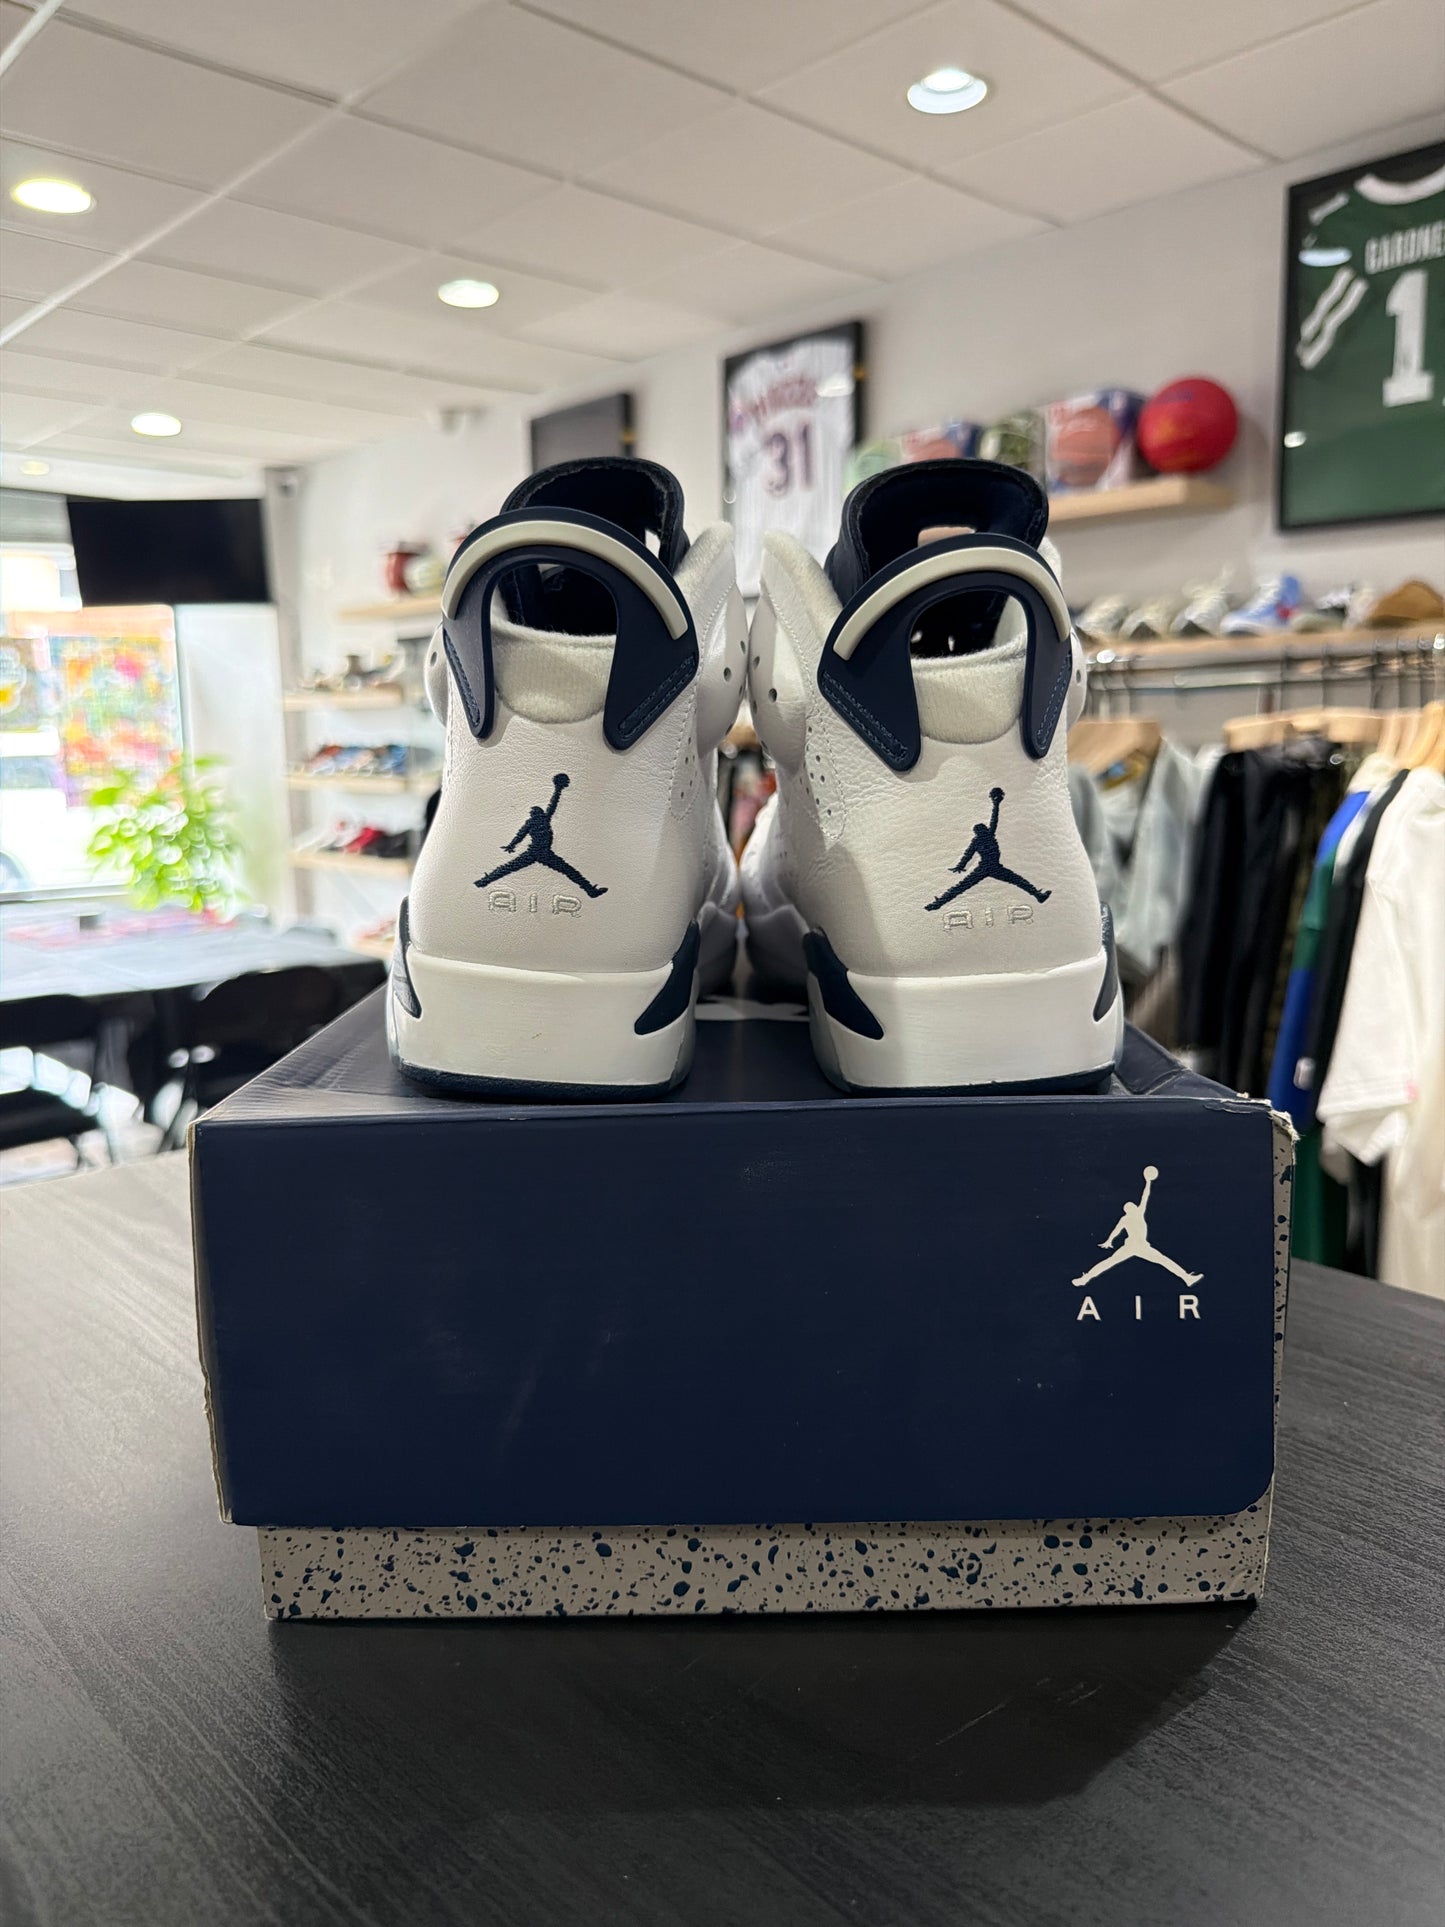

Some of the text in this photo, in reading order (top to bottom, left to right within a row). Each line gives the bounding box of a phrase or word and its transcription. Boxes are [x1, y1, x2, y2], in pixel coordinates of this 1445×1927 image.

[1383, 268, 1433, 408] 1
[764, 419, 814, 500] 31
[488, 890, 582, 918] AIR
[943, 904, 1034, 932] AIR
[1076, 1294, 1201, 1321] AIR
